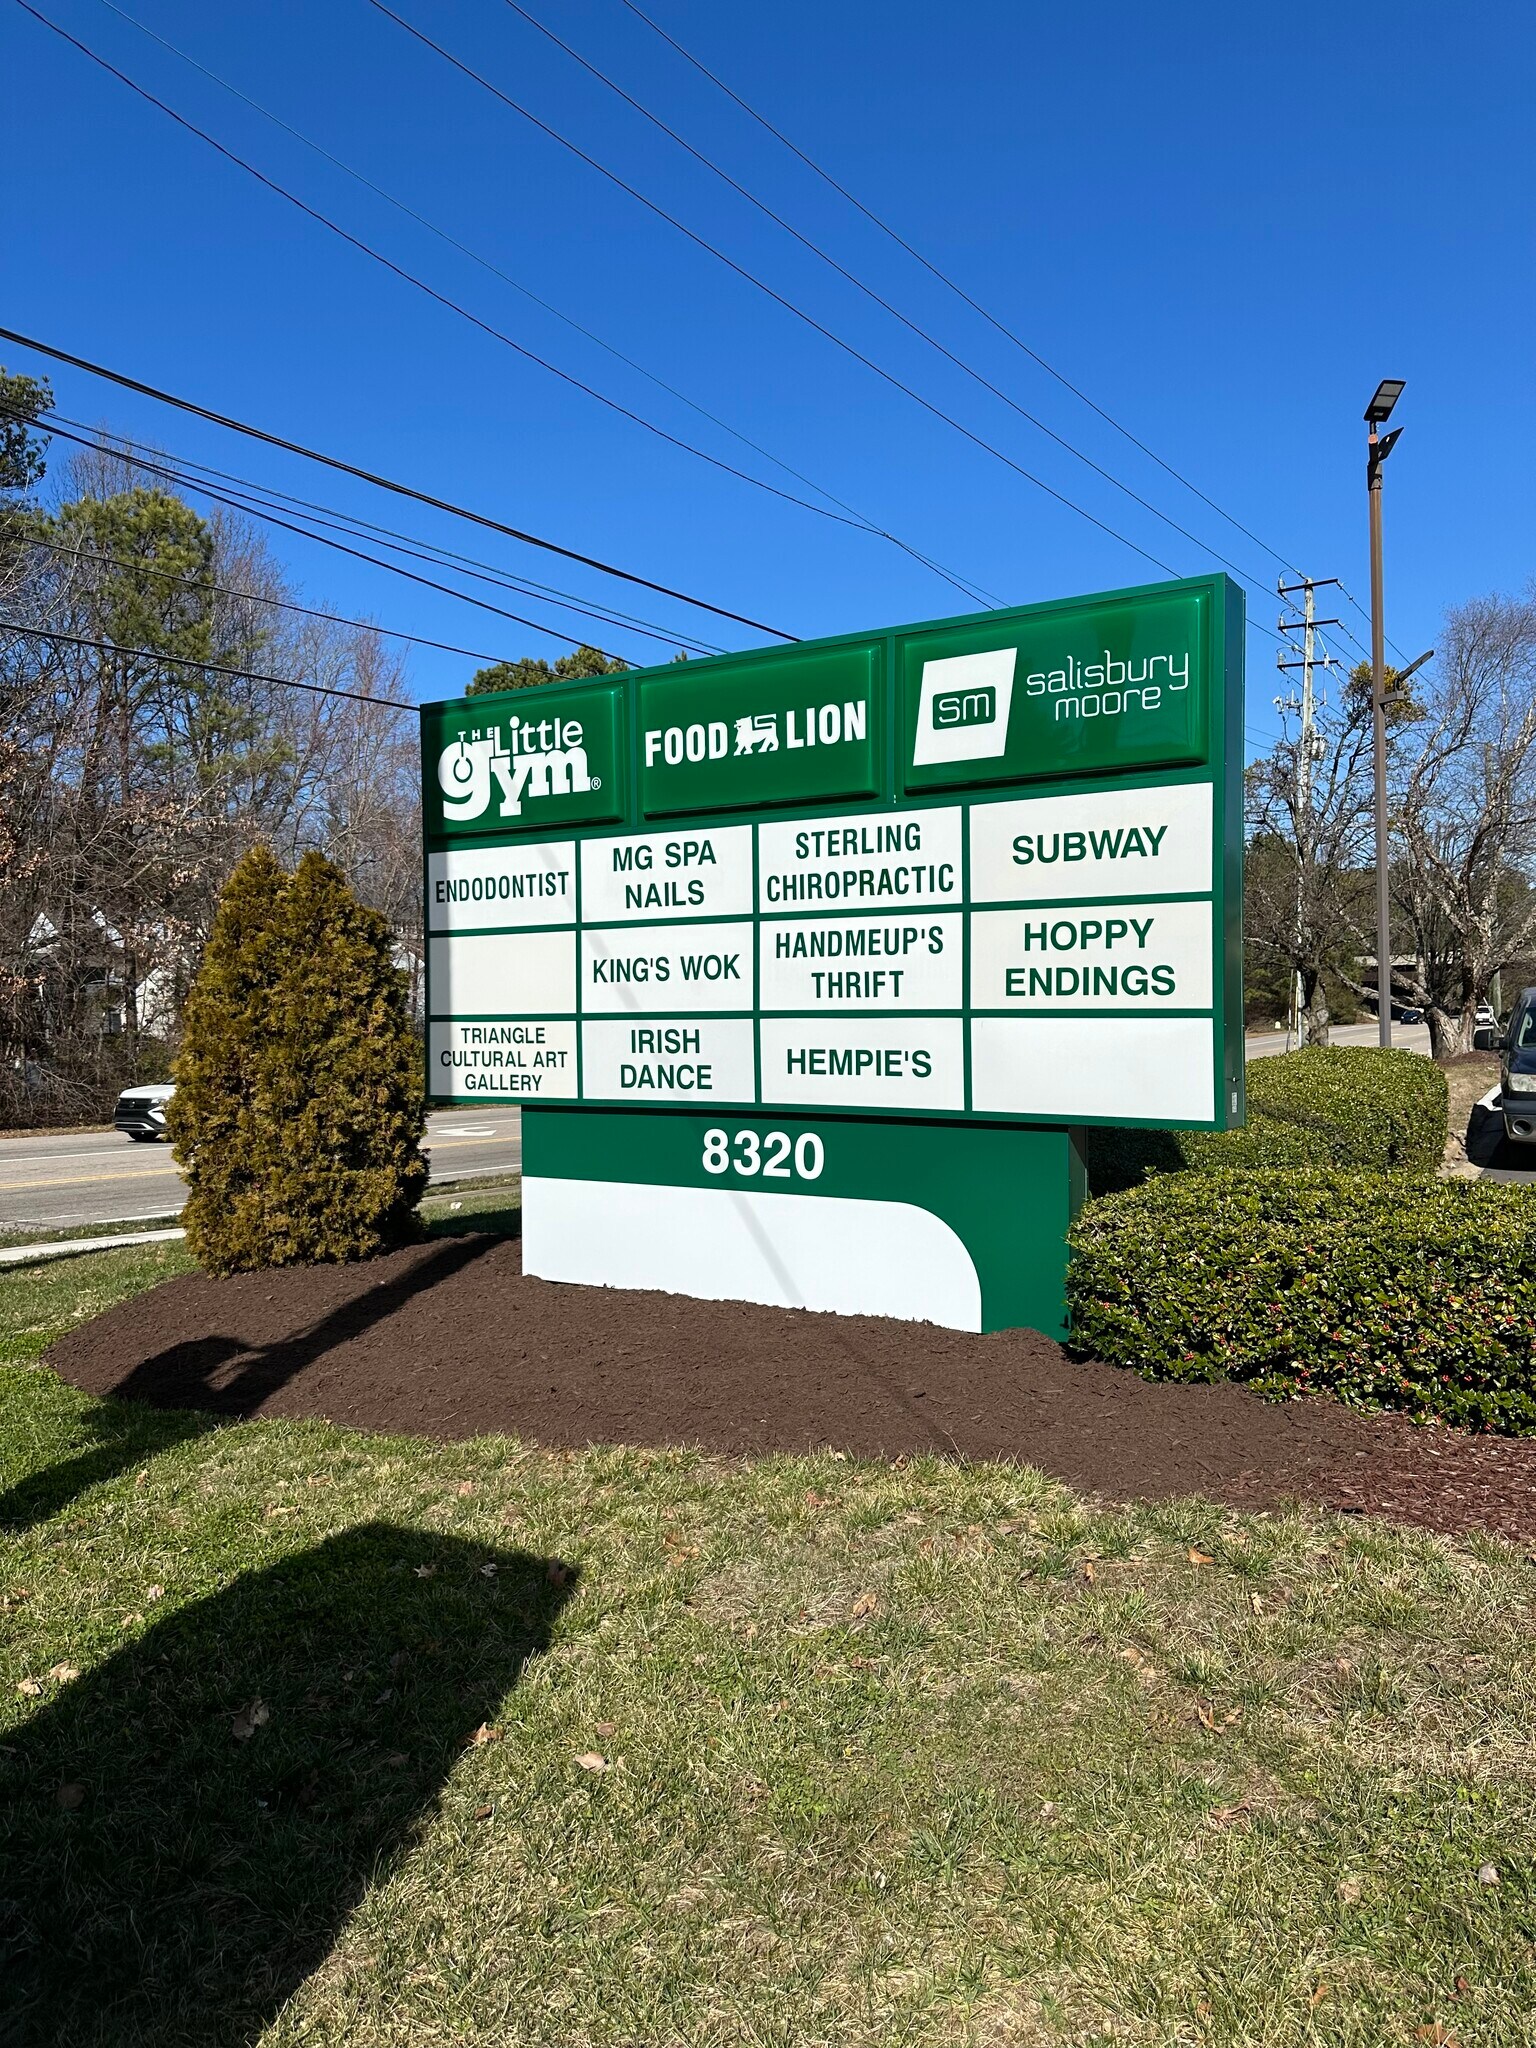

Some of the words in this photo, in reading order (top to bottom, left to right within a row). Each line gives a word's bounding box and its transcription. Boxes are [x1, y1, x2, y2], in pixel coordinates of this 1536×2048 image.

[1026, 649, 1189, 696] salisbury
[937, 693, 990, 724] sm
[1055, 685, 1161, 721] moore
[457, 727, 494, 742] THE
[493, 716, 584, 757] Little
[646, 722, 727, 767] FOOD
[787, 701, 865, 748] LION
[614, 845, 652, 871] MG
[666, 840, 716, 867] SPA
[795, 822, 921, 859] STERLING
[1013, 826, 1168, 865] SUBWAY
[436, 872, 568, 903] ENDODONTIST
[626, 880, 704, 908] NAILS
[766, 863, 955, 902] CHIROPRACTIC
[776, 926, 943, 958] HANDMEUP'S
[1025, 919, 1154, 951] HOPPY
[594, 957, 670, 983] KING'S
[680, 954, 740, 980] WOK
[1006, 965, 1175, 996] ENDINGS
[811, 971, 903, 998] THRIFT
[461, 1028, 545, 1044] TRIANGLE
[632, 1029, 699, 1054] IRISH
[441, 1051, 526, 1067] CULTURAL
[533, 1051, 567, 1067] ART
[788, 1049, 931, 1077] HEMPIE'S
[465, 1074, 542, 1091] GALLERY
[621, 1065, 712, 1089] DANCE
[702, 1128, 825, 1180] 8320
